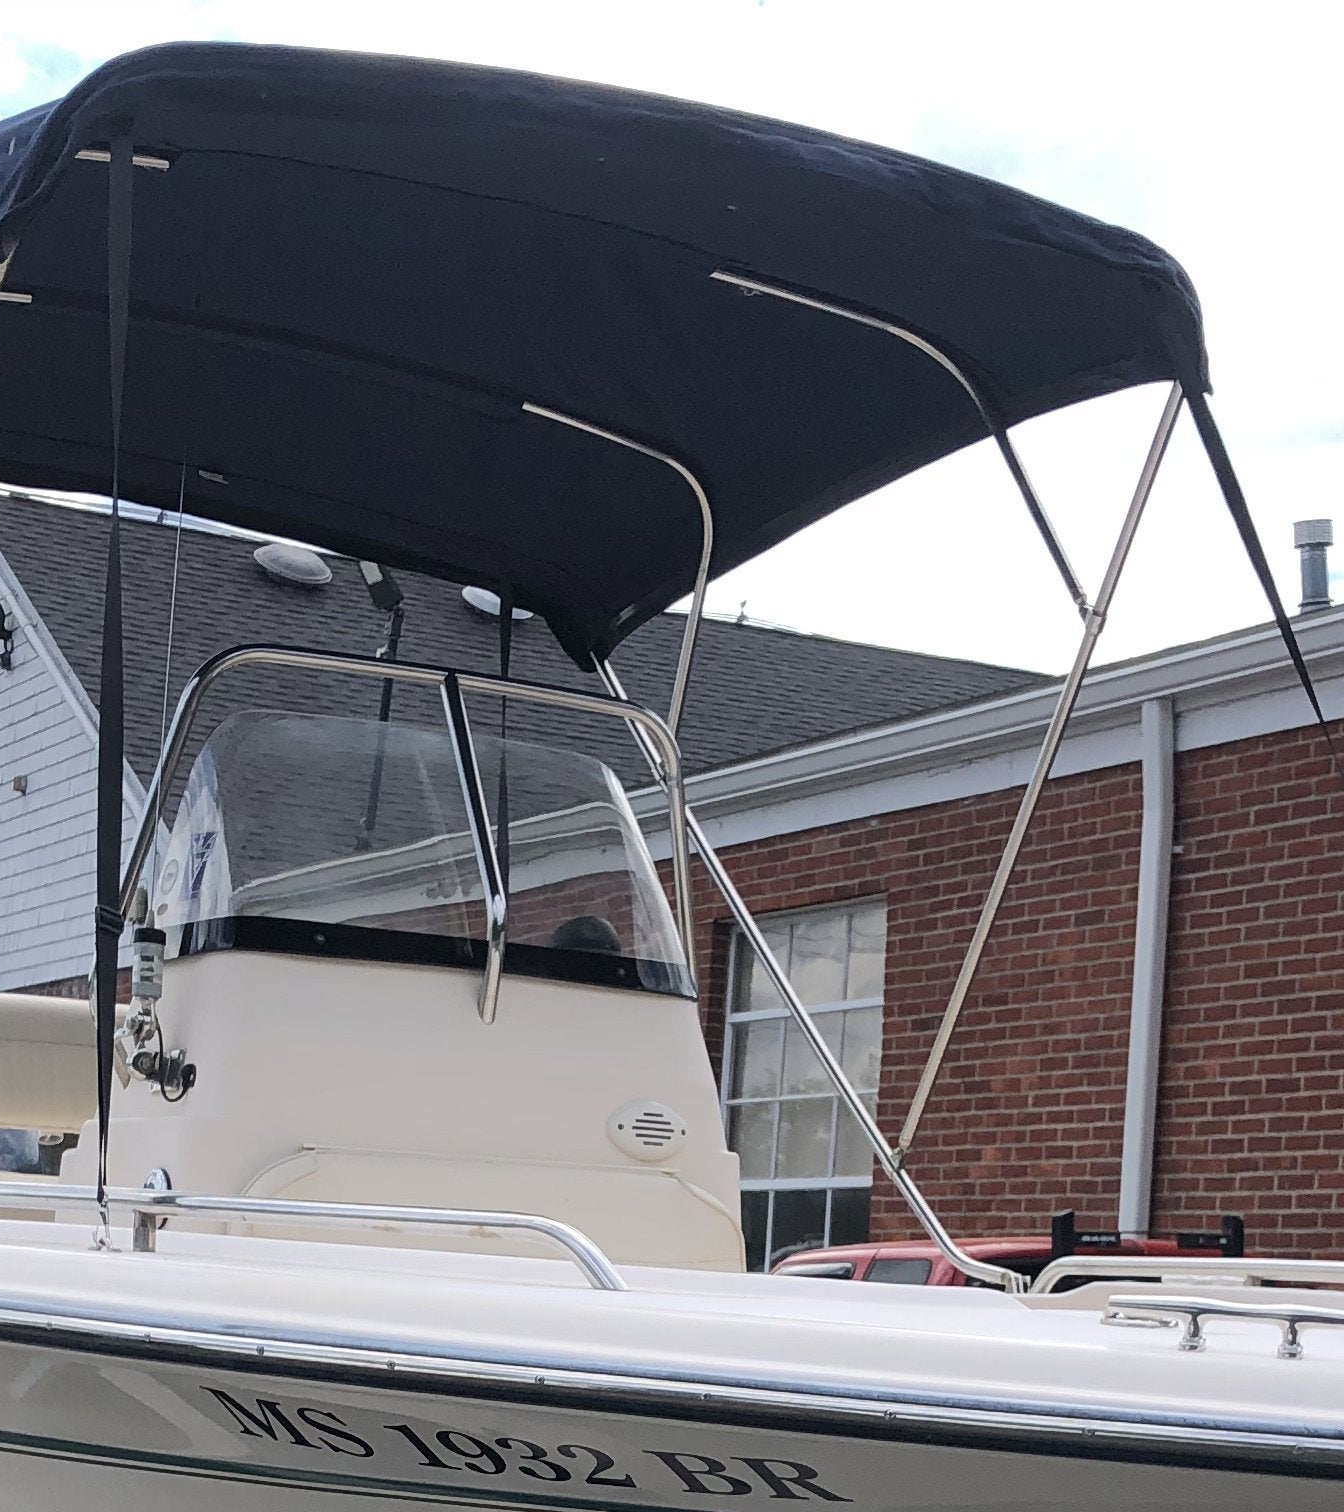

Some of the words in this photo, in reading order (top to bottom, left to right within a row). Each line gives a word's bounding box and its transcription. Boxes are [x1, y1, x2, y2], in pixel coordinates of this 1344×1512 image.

[200, 1386, 375, 1458] MS
[385, 1424, 637, 1489] 1932
[643, 1449, 855, 1503] BR
